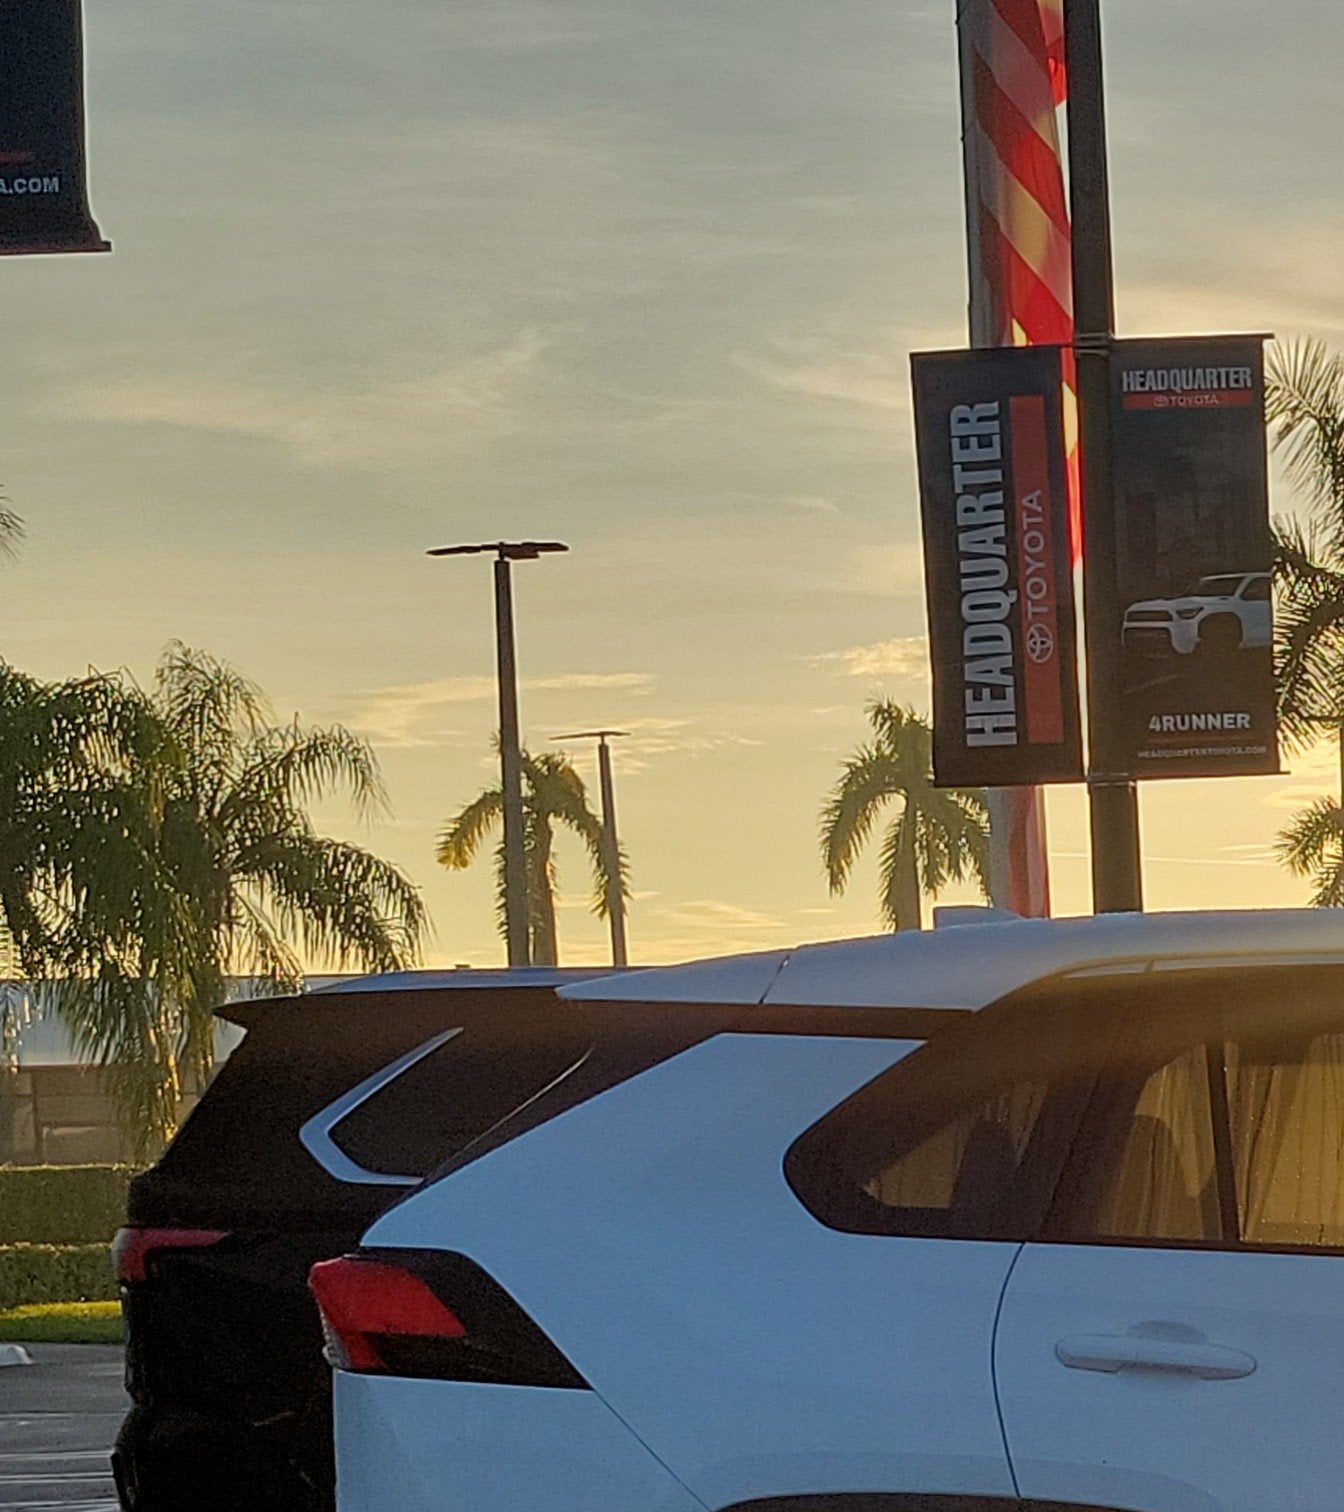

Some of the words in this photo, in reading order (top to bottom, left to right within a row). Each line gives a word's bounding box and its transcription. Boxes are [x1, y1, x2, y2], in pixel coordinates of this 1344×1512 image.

[1122, 366, 1252, 393] HEADQUARTER
[1169, 395, 1219, 407] TOYOTA
[1020, 488, 1048, 619] TOYOTA
[950, 400, 1018, 748] HEADQUARTER
[1149, 713, 1251, 732] 4RUNNER
